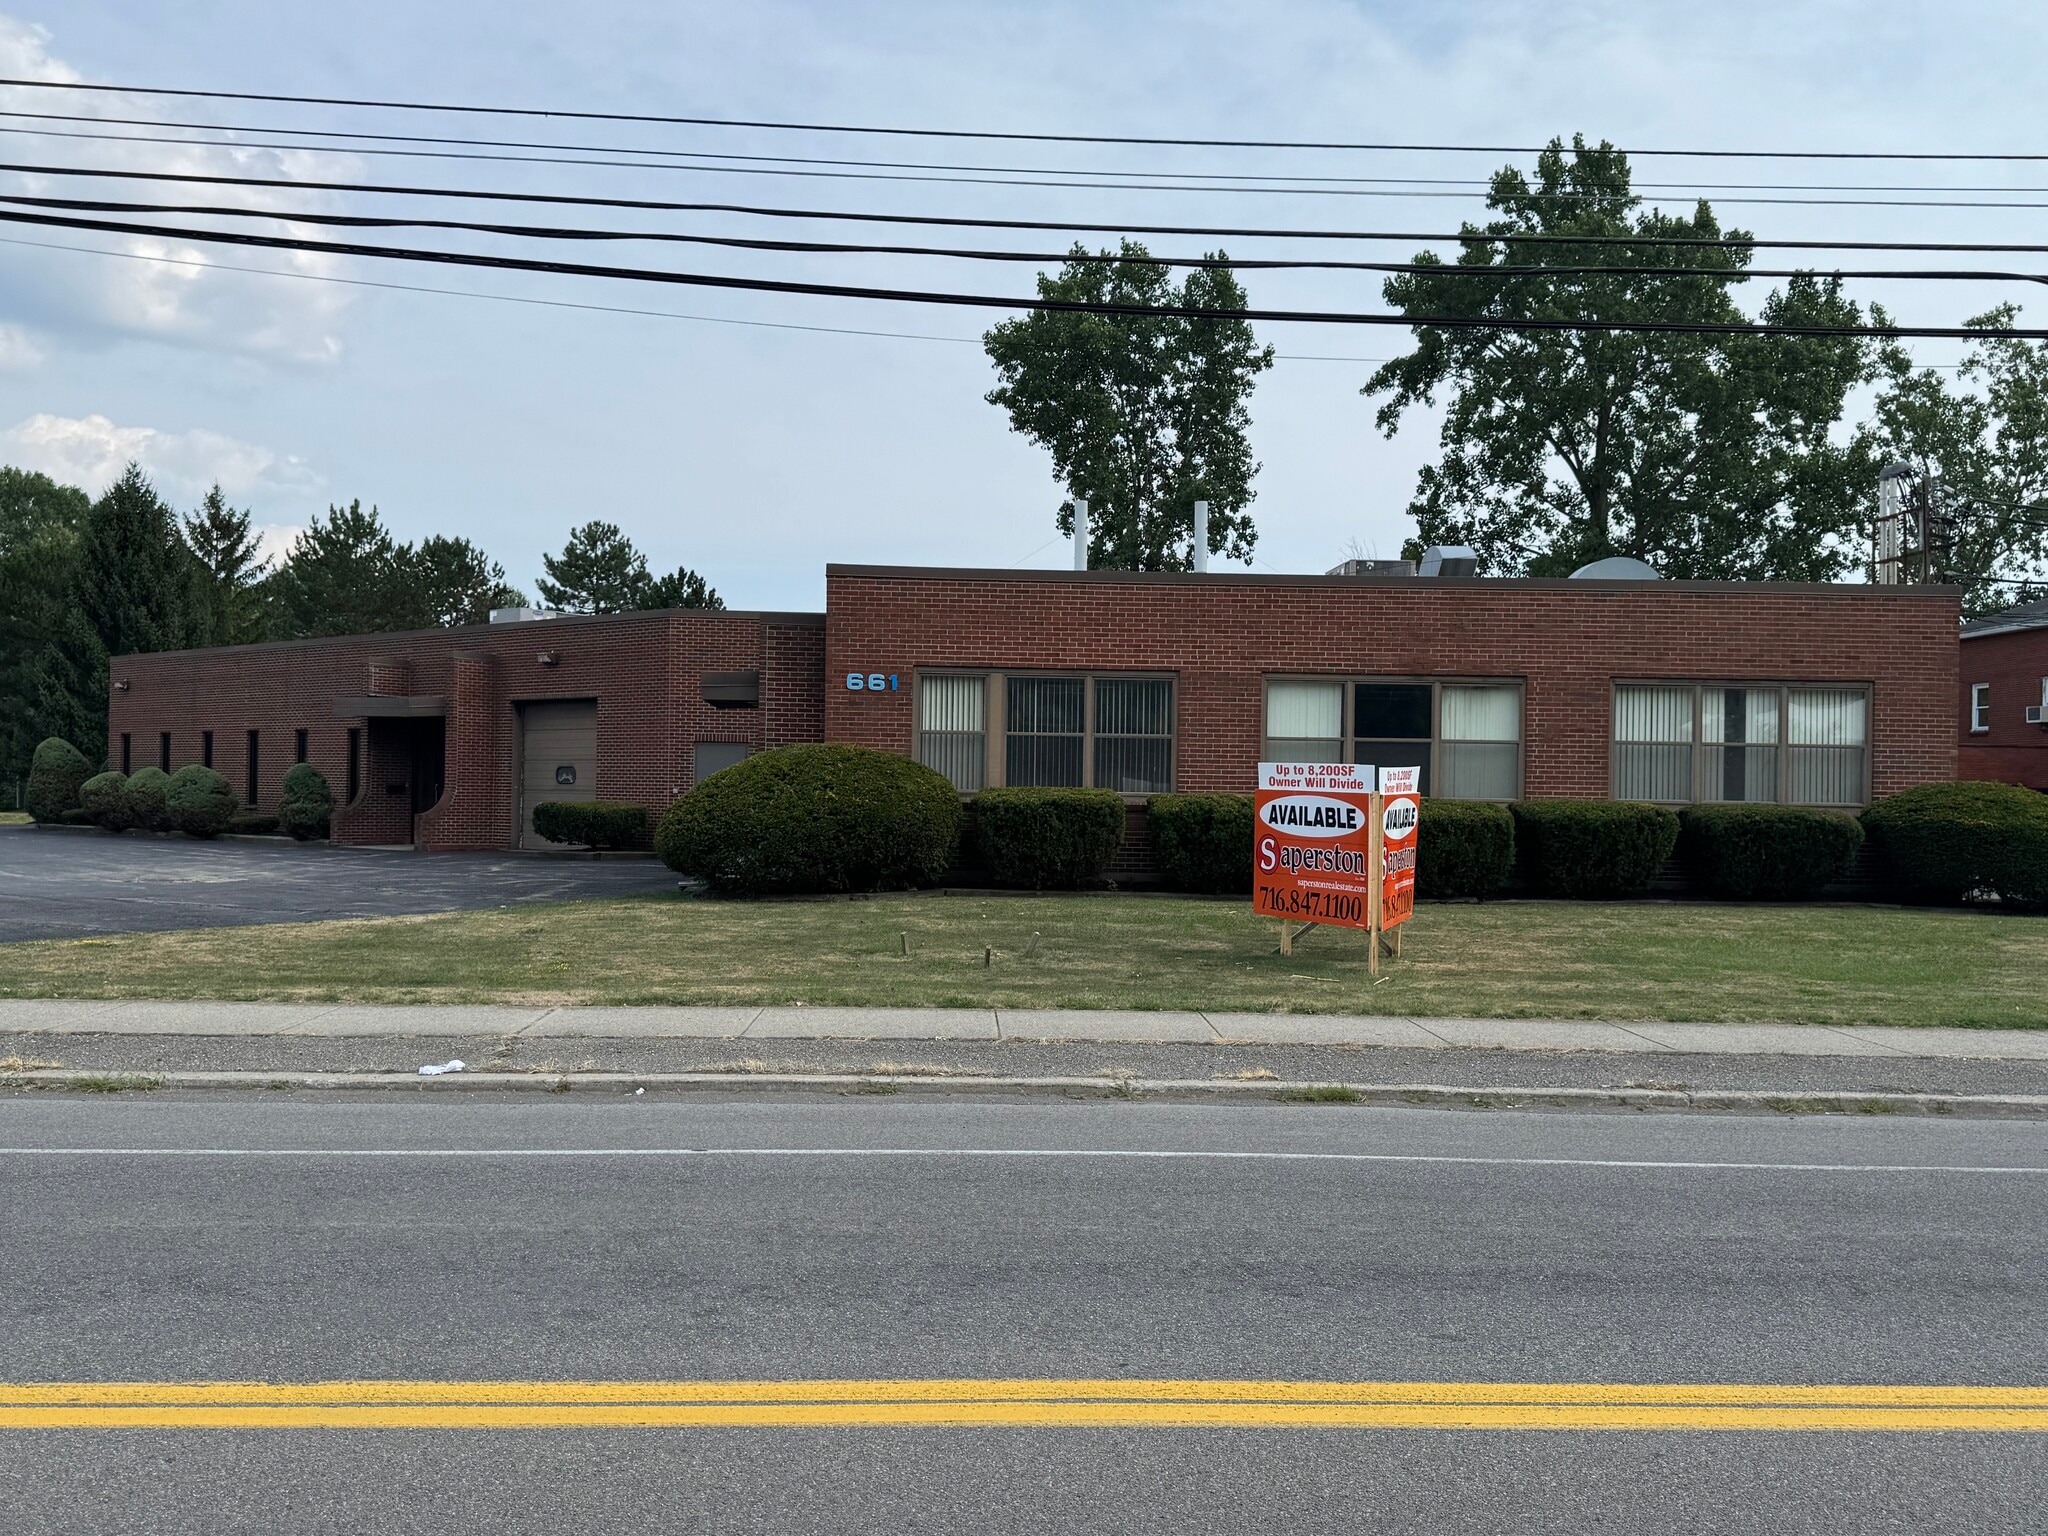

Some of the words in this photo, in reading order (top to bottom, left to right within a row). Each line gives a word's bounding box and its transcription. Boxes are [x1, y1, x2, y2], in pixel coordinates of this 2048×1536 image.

[846, 673, 898, 691] 661
[1276, 764, 1290, 777] Up
[1293, 765, 1304, 775] to
[1308, 765, 1355, 777] 8,200SF
[1268, 776, 1301, 787] Owner
[1305, 777, 1326, 788] Will
[1329, 778, 1364, 790] Divide
[1268, 804, 1357, 829] AVAILABLE
[1385, 807, 1415, 831] AVAILABLE
[1260, 838, 1366, 876] Saperston
[1297, 879, 1367, 893] saperstonrealestate.com
[1260, 886, 1362, 922] 716.847.1100
